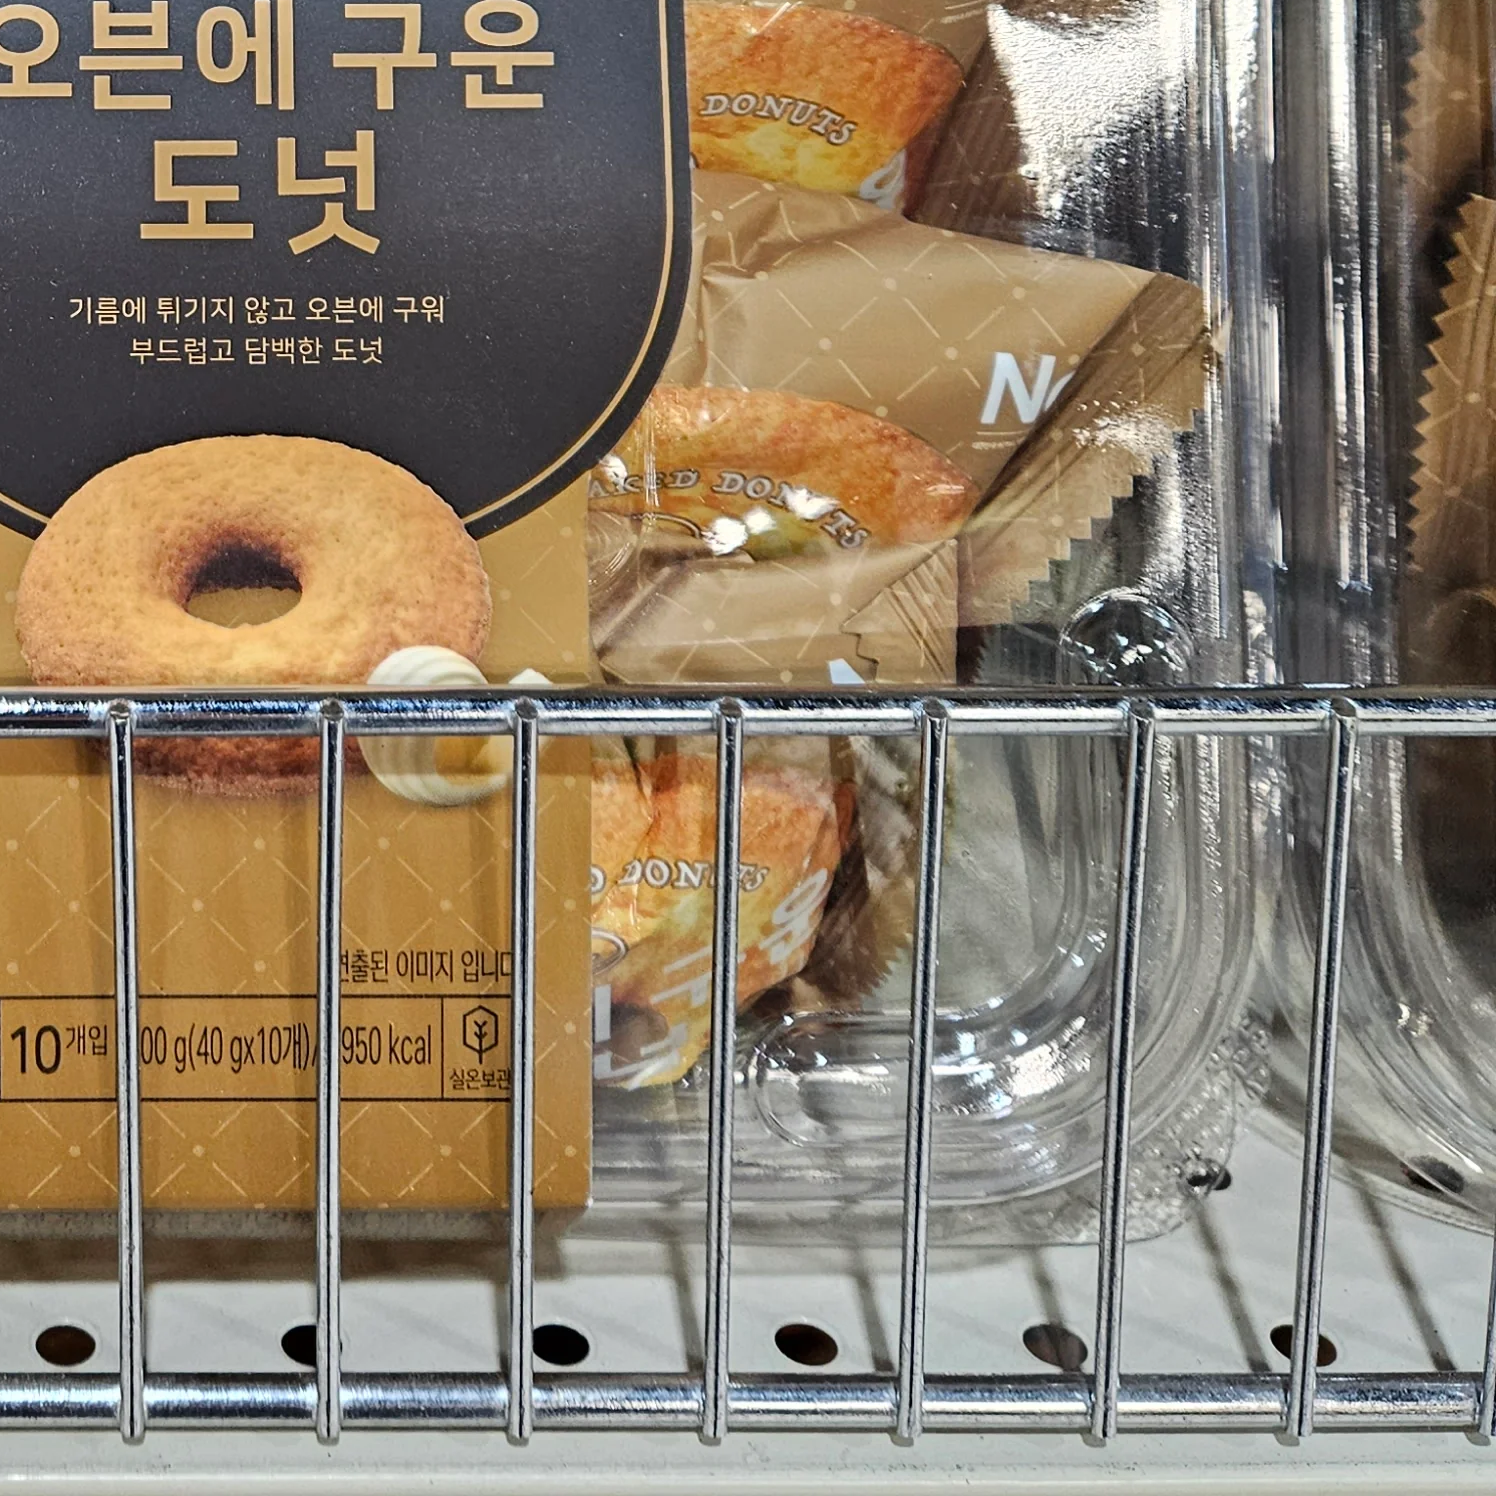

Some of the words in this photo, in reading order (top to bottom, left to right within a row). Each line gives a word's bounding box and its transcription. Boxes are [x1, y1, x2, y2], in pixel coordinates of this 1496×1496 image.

[698, 90, 860, 146] DONUTS
[139, 129, 380, 255] 도넛
[68, 295, 147, 325] 기름에
[156, 295, 235, 325] 튀기지
[244, 295, 296, 325] 않고
[305, 294, 384, 325] 오븐에
[393, 294, 446, 325] 구워
[129, 337, 236, 366] 부드럽고
[244, 336, 324, 366] 담백한
[331, 337, 384, 365] 도넛
[396, 949, 454, 984] 이미지
[389, 1024, 431, 1066] kcal
